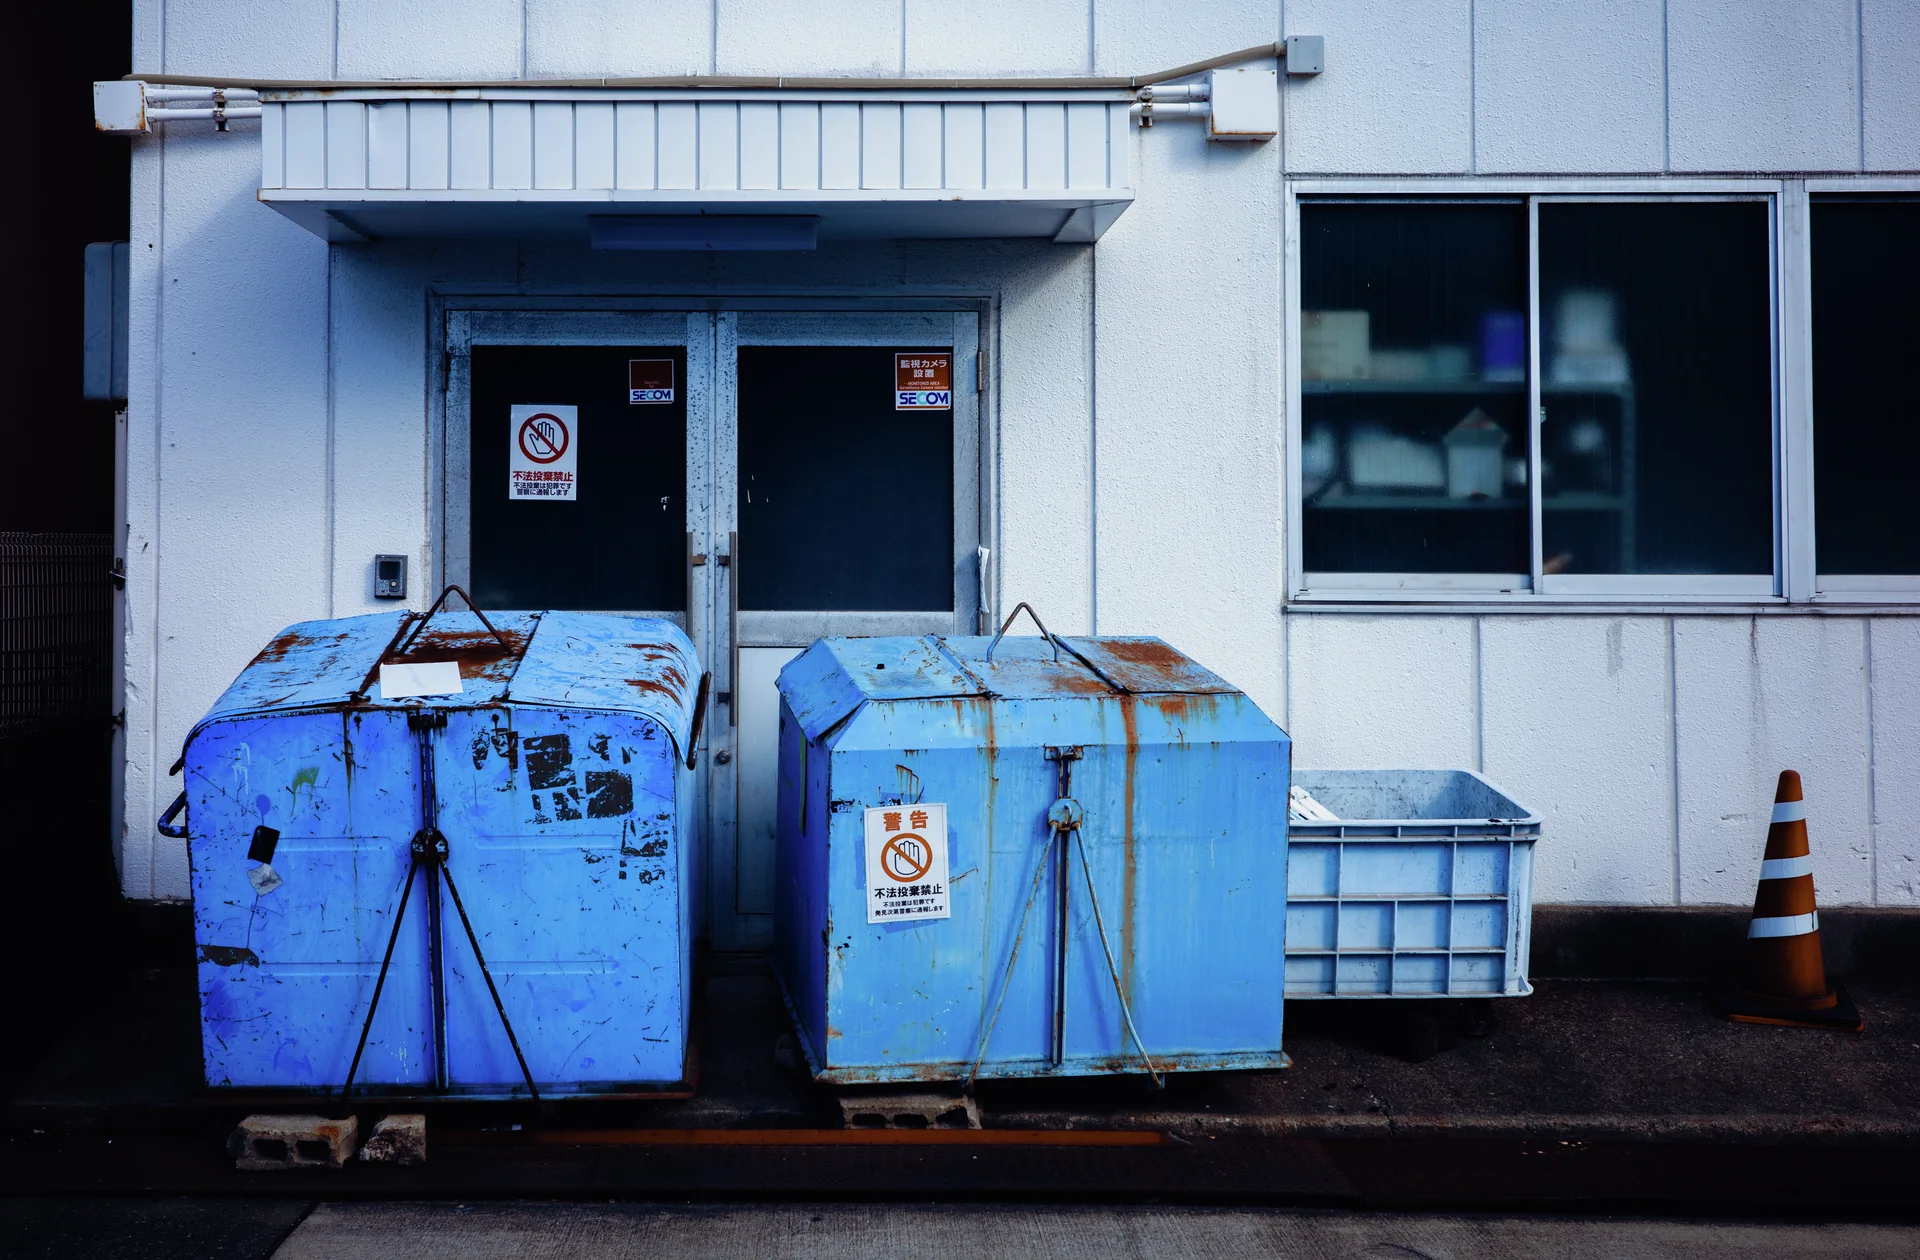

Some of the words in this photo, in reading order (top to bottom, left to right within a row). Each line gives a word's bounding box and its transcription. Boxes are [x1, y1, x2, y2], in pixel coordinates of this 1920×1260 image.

[900, 359, 948, 368] 監視カメラ
[913, 369, 935, 378] 設置
[632, 390, 671, 400] SECOM
[899, 392, 949, 405] SECOM
[512, 471, 573, 482] 不法投棄禁止
[883, 810, 928, 832] 警告
[874, 883, 943, 900] 不法投棄禁止
[883, 898, 935, 907] 不法投棄は犯罪です
[875, 905, 944, 917] 発見次第警察に通報します
